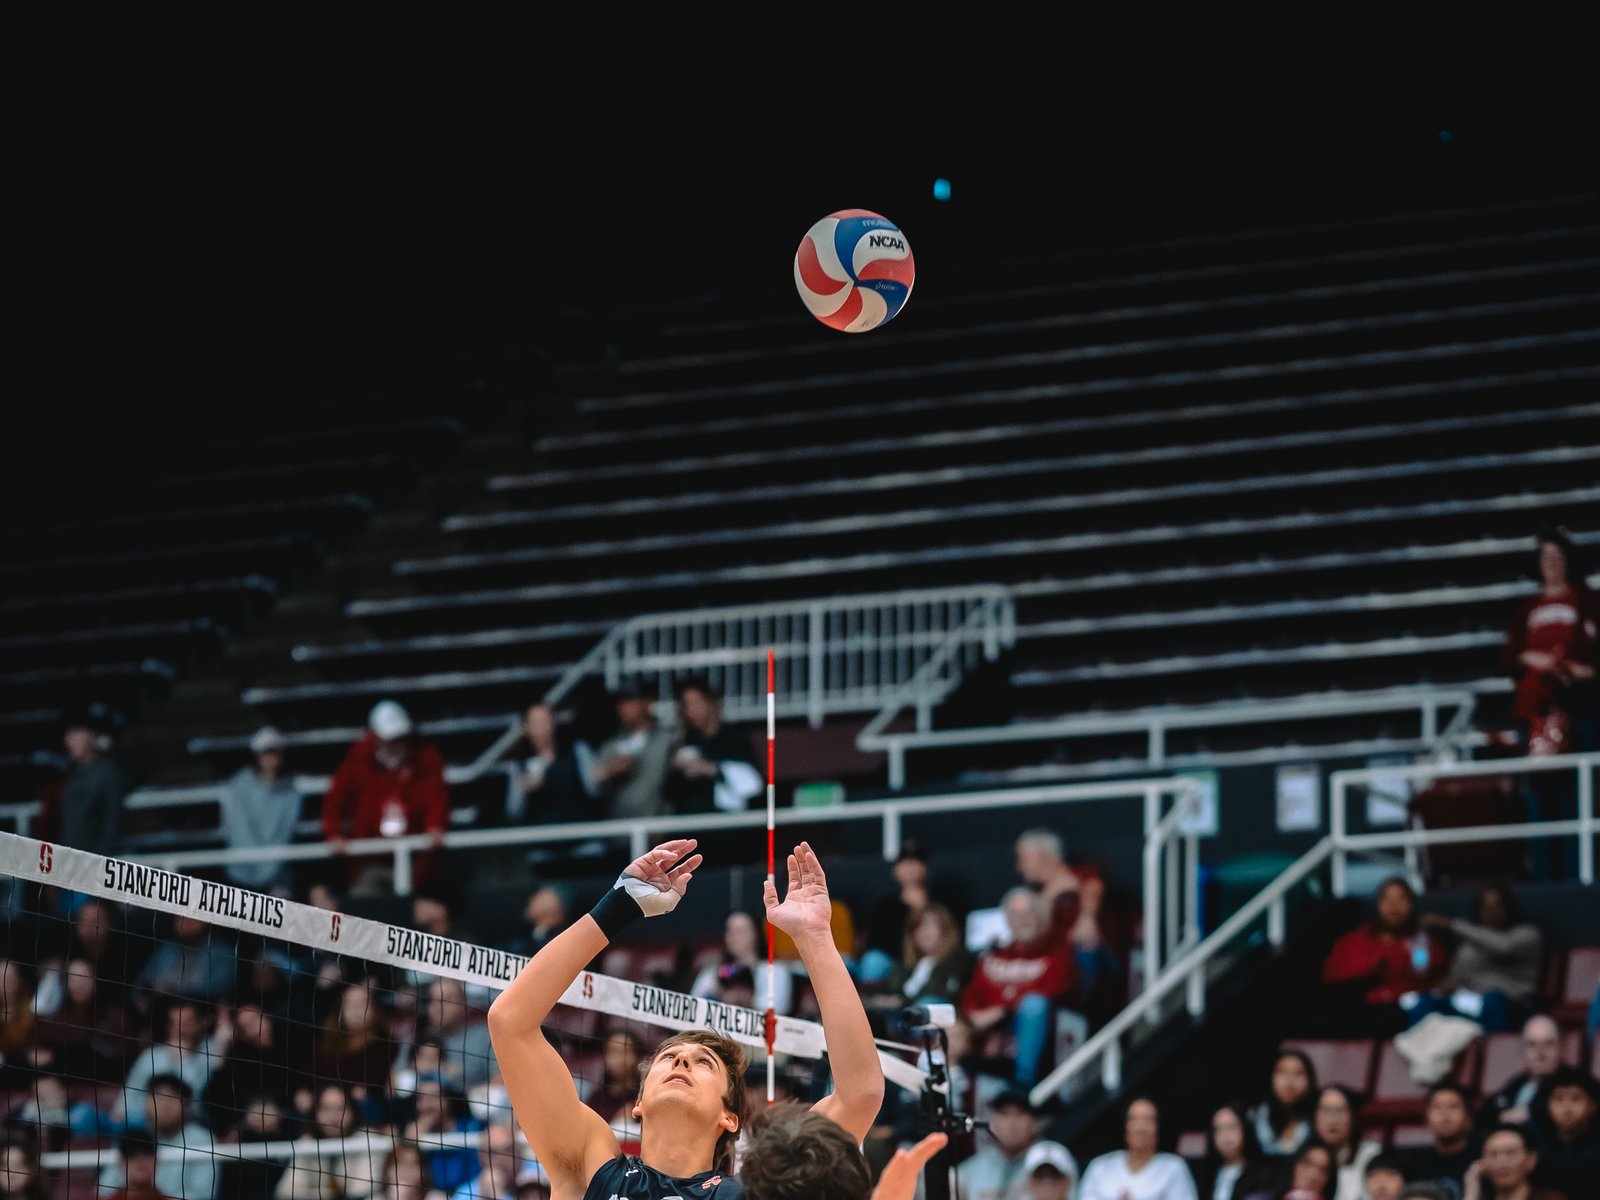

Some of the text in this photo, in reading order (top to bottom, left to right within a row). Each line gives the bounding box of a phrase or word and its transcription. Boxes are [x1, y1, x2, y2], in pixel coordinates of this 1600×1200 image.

[869, 235, 905, 252] NCAA
[104, 858, 284, 928] STANFORD ATHLETICS
[387, 926, 530, 981] STANFORD ATHLET
[632, 985, 767, 1038] STANFORD ATHLETICS
